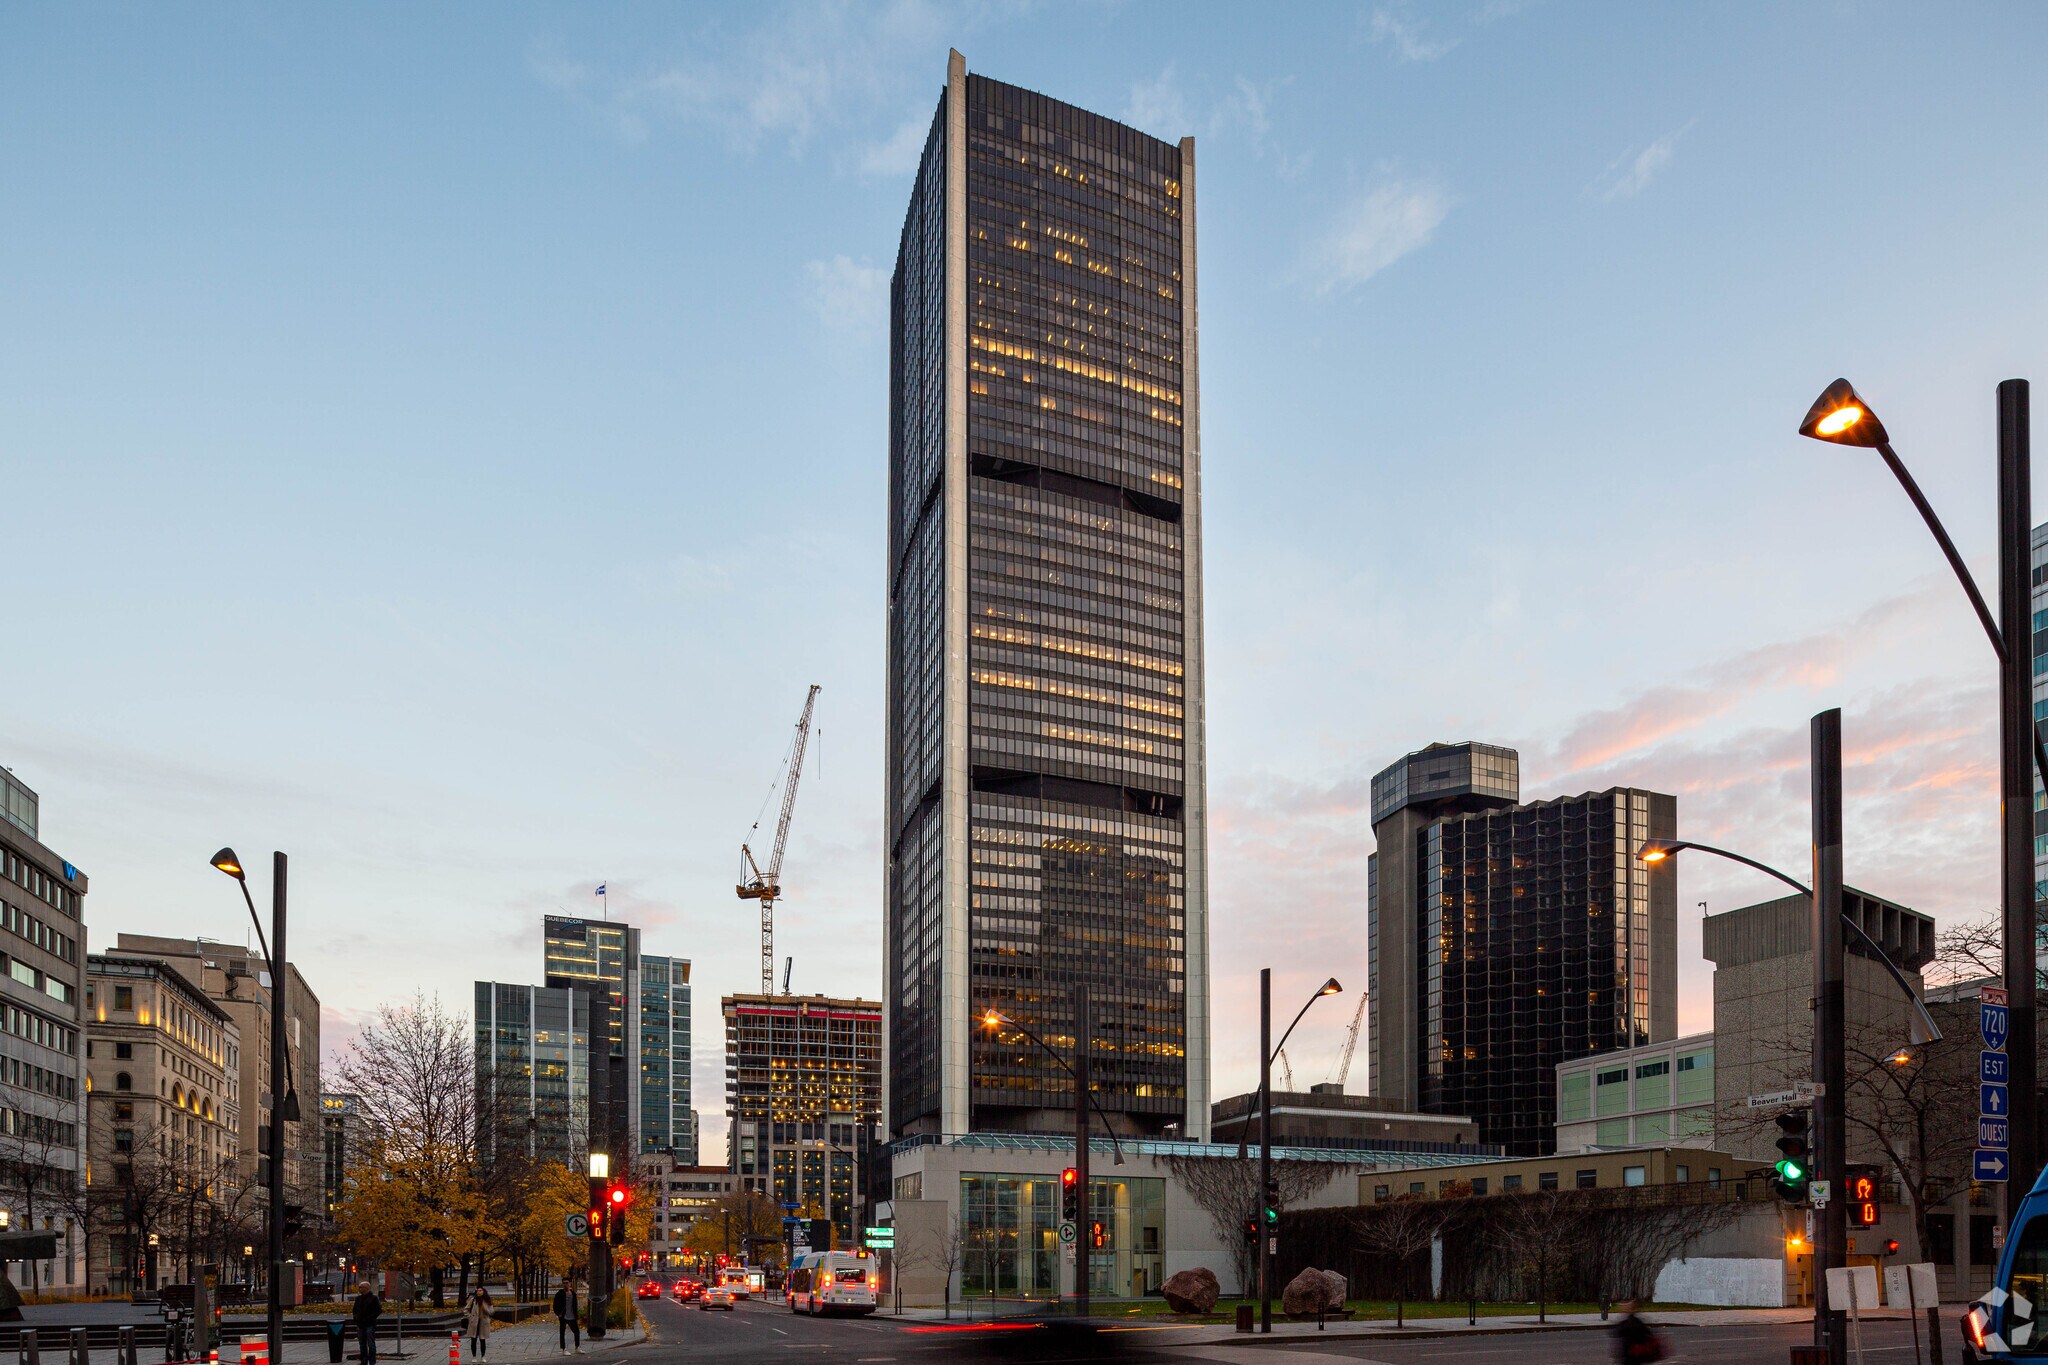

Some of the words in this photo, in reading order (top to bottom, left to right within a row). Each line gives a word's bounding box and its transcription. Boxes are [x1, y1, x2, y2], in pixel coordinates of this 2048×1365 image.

[62, 860, 77, 881] W
[1984, 1009, 2005, 1035] 720
[1984, 1059, 2004, 1076] EST
[1797, 1085, 1812, 1095] Viger
[1751, 1096, 1778, 1106] Beaver
[1781, 1093, 1797, 1102] Hall
[1981, 1123, 2007, 1142] OUEST
[301, 1153, 322, 1162] Viger
